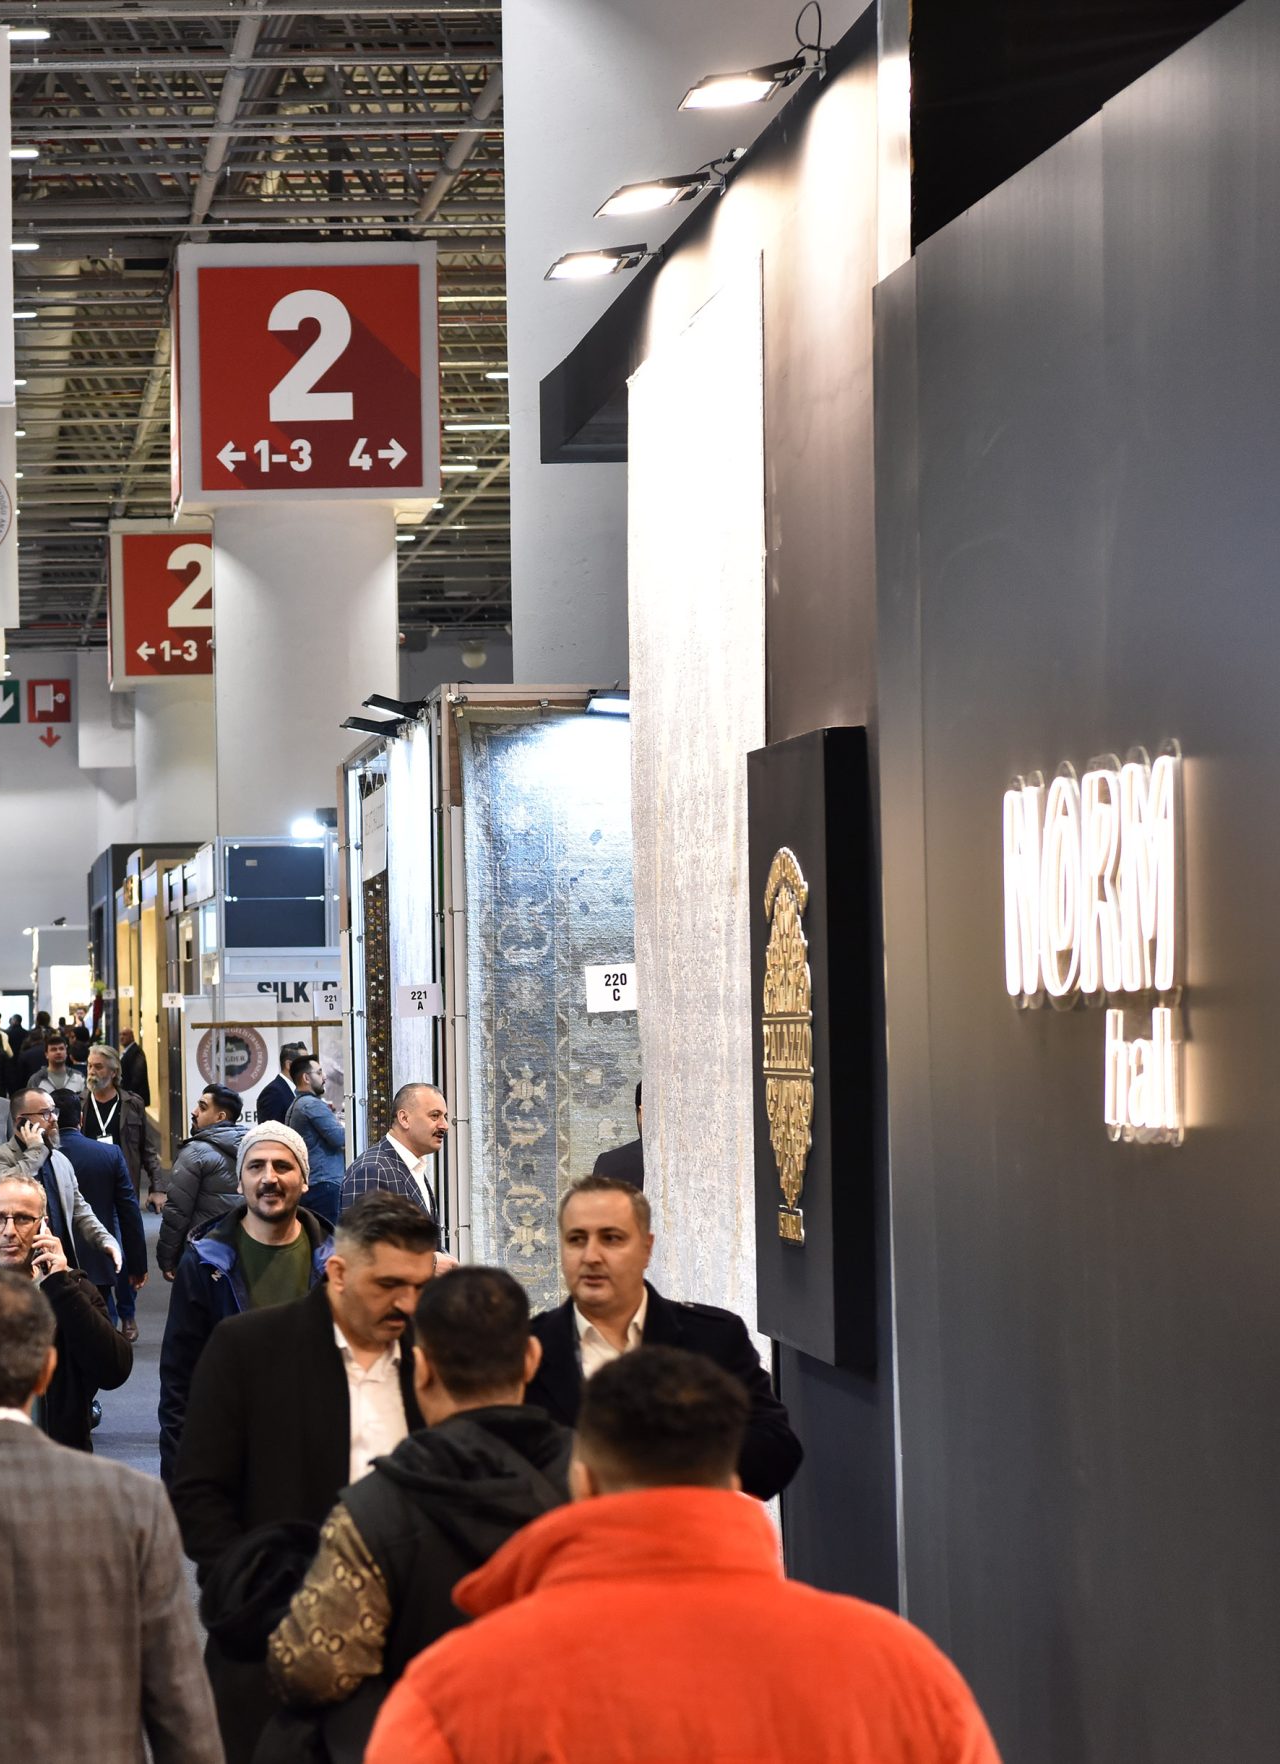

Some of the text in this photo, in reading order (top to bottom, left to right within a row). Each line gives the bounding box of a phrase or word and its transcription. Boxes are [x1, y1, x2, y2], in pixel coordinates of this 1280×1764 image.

[267, 289, 354, 422] 2
[253, 437, 373, 473] 1-3 4
[166, 542, 213, 628] 2
[159, 639, 198, 662] 1-3
[1001, 754, 1175, 997] NORM
[604, 972, 628, 987] 220
[324, 995, 337, 1003] 221
[410, 990, 428, 1000] 221
[612, 988, 621, 1001] C
[329, 1003, 334, 1011] D
[417, 1001, 424, 1011] A
[763, 1022, 810, 1071] PALAZZO
